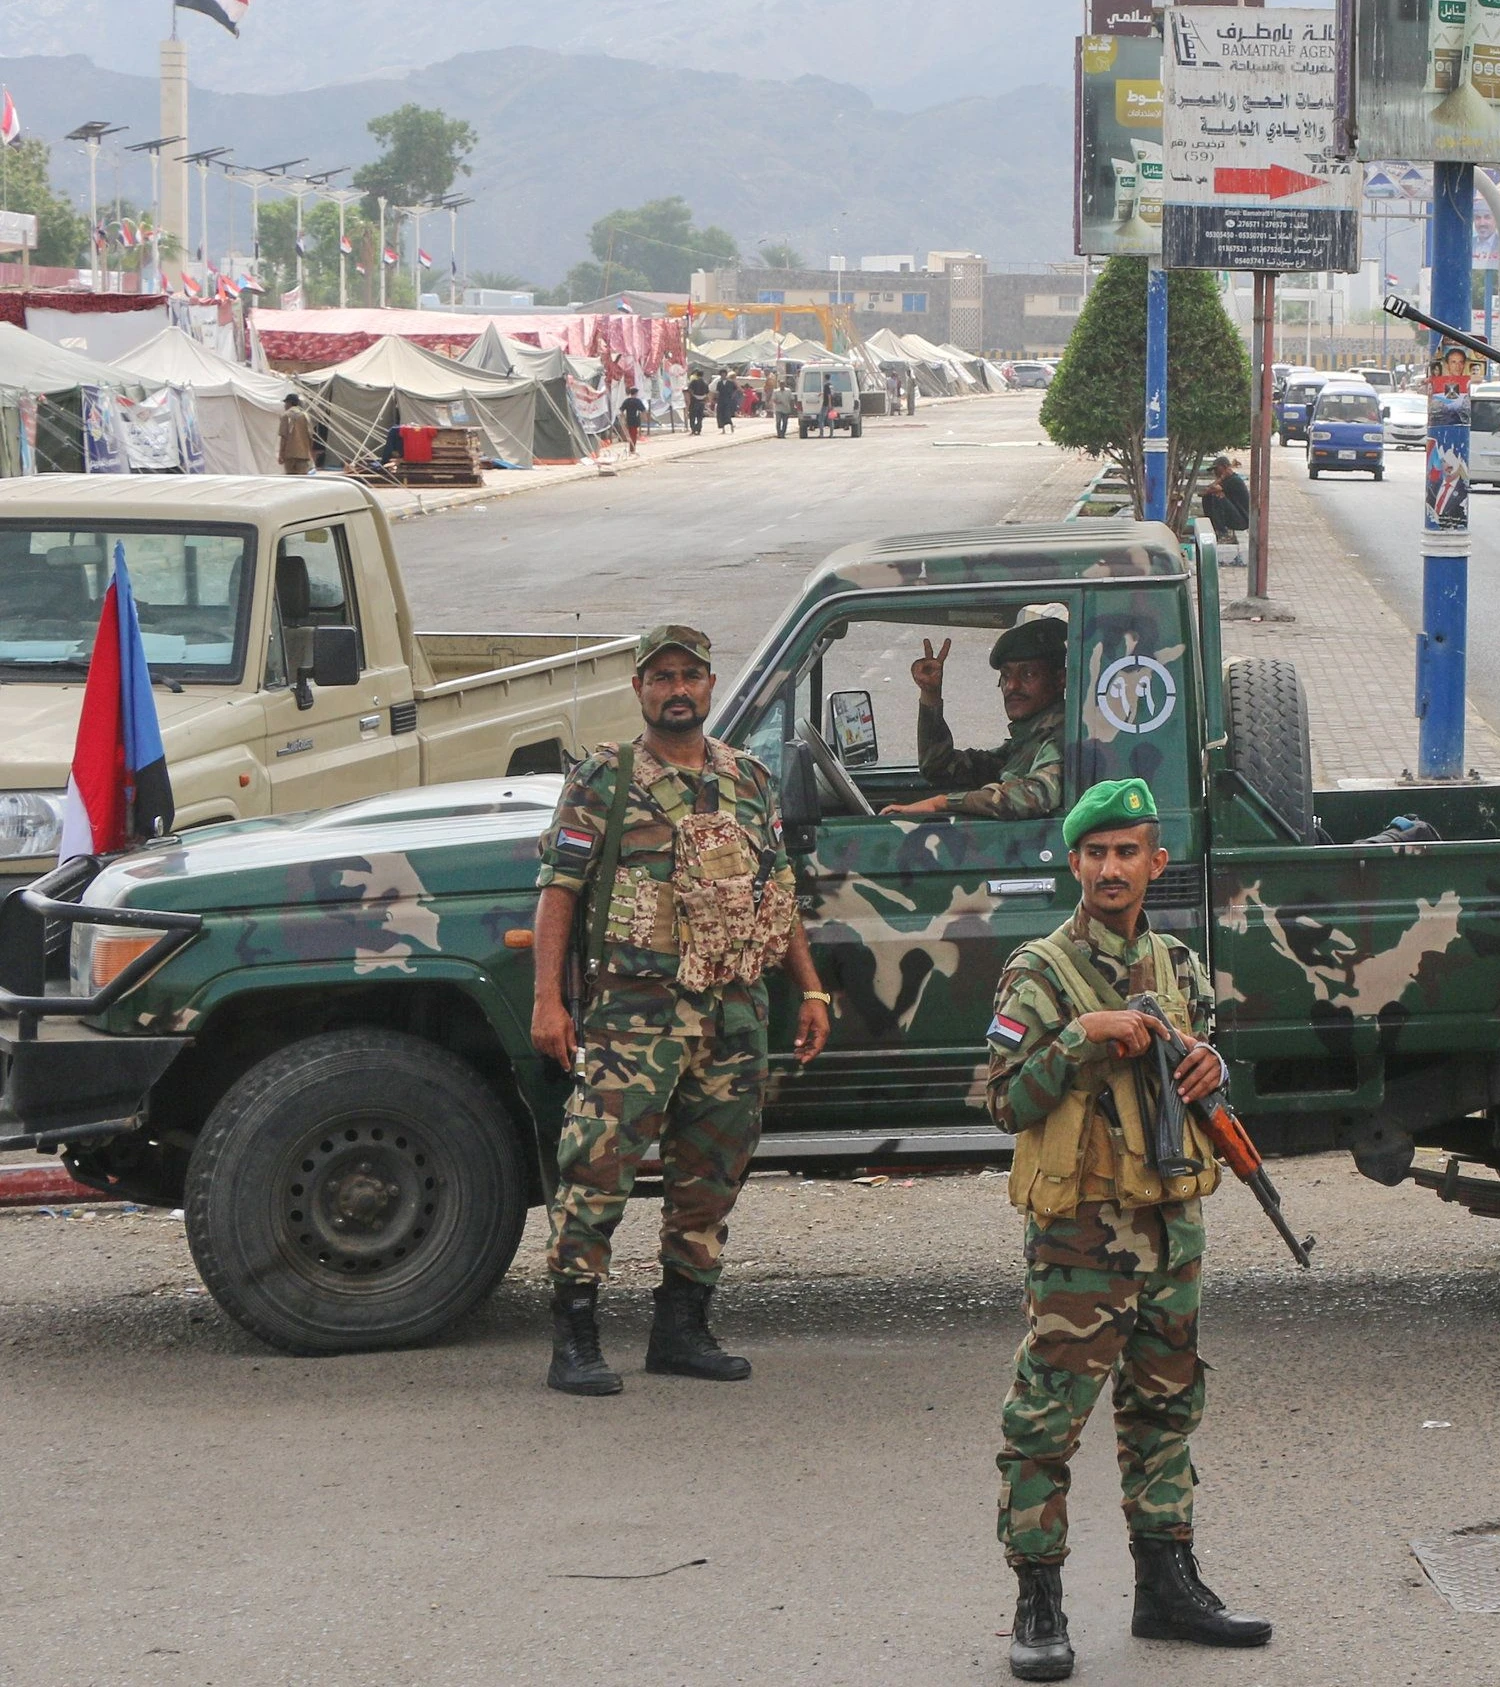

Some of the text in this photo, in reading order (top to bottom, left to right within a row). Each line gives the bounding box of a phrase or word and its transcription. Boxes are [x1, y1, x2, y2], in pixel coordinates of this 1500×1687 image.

[1106, 9, 1152, 29] سلامي
[1222, 43, 1335, 59] BAMATRAF AGEN
[1184, 151, 1215, 162] (59)
[1310, 164, 1351, 175] IATA
